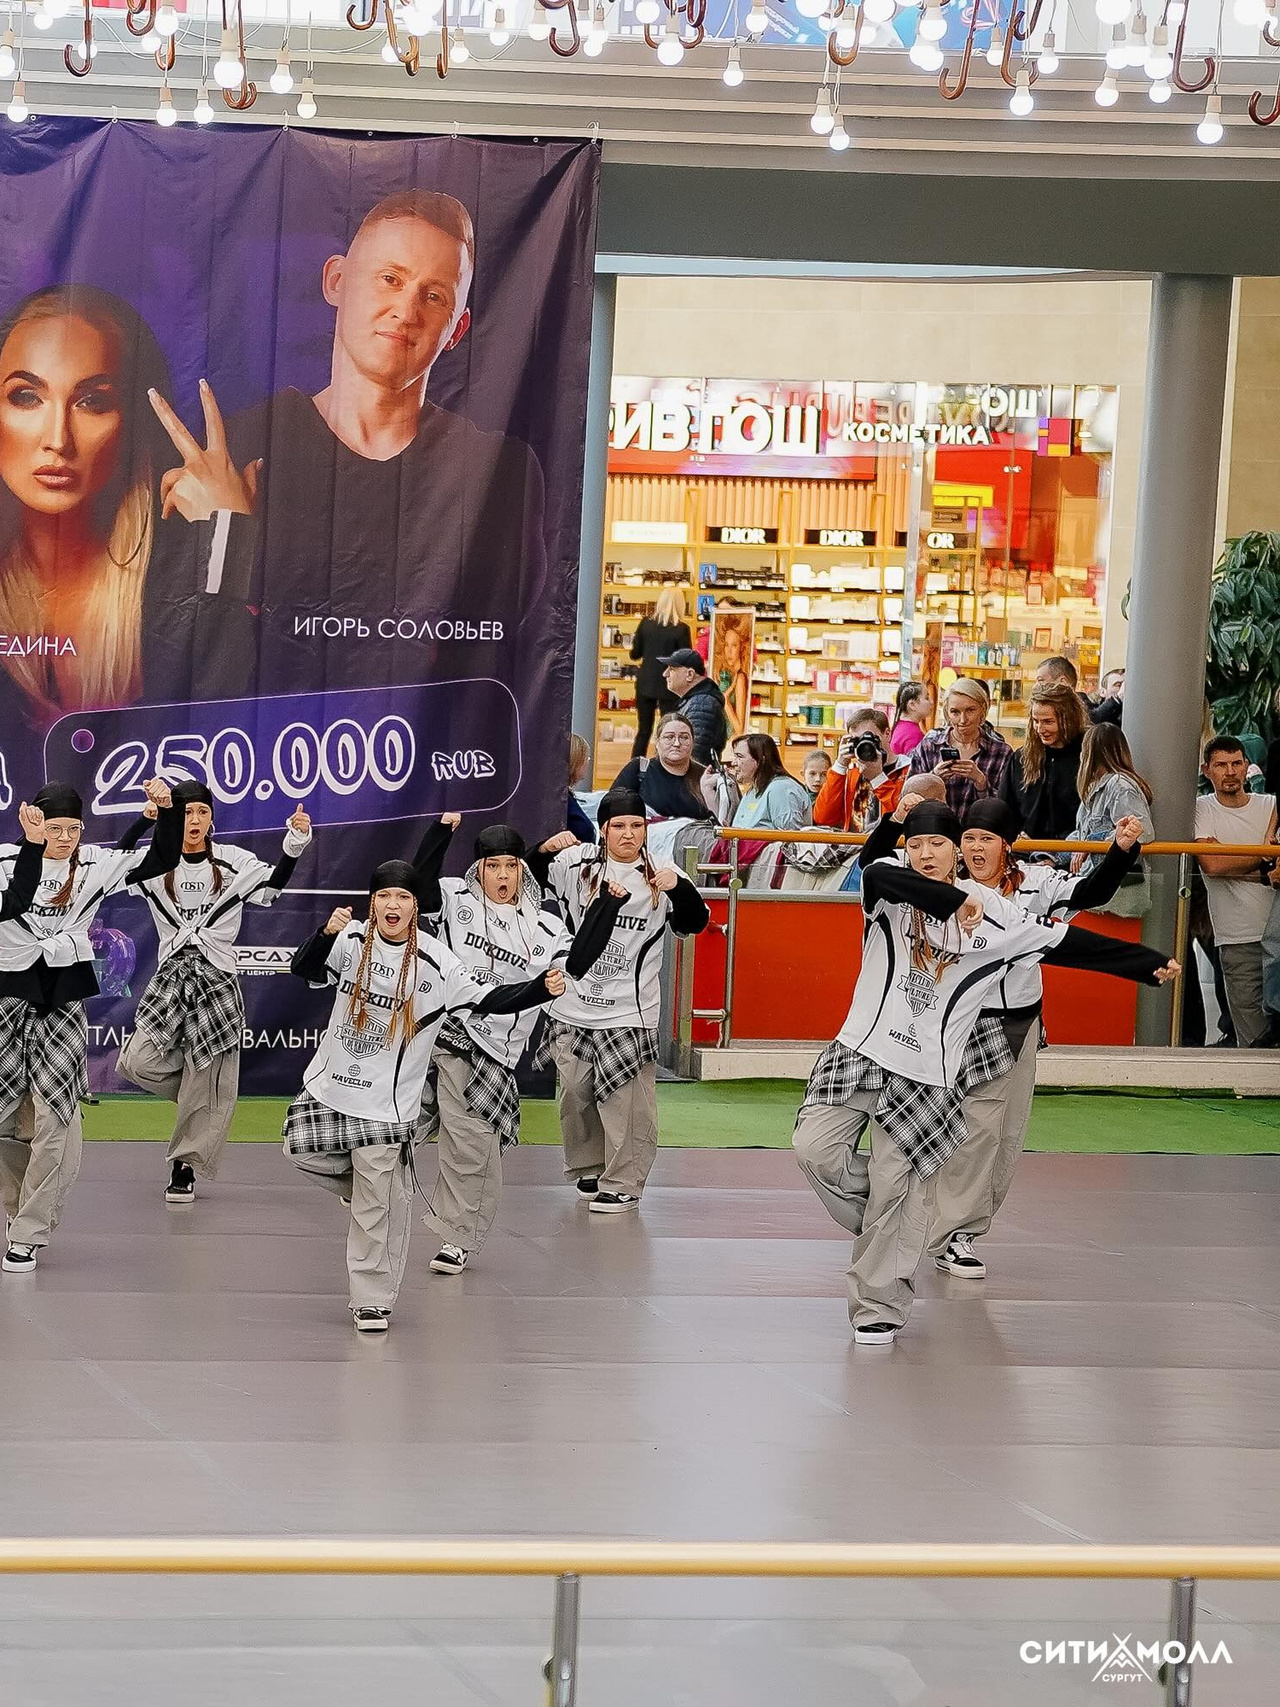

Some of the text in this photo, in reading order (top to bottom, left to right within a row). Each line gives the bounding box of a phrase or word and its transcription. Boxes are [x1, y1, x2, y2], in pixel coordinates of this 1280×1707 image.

[982, 388, 1038, 418] ОШ
[842, 421, 991, 446] КОСМЕТИКА
[721, 527, 767, 545] DIOR
[819, 529, 865, 547] DIOR
[926, 532, 955, 549] OR
[294, 616, 505, 641] ИГОРЬ СОЛОВЬЕВ
[90, 714, 416, 816] 250.000
[430, 749, 497, 781] RUB
[331, 1072, 373, 1089] WAVECLUB
